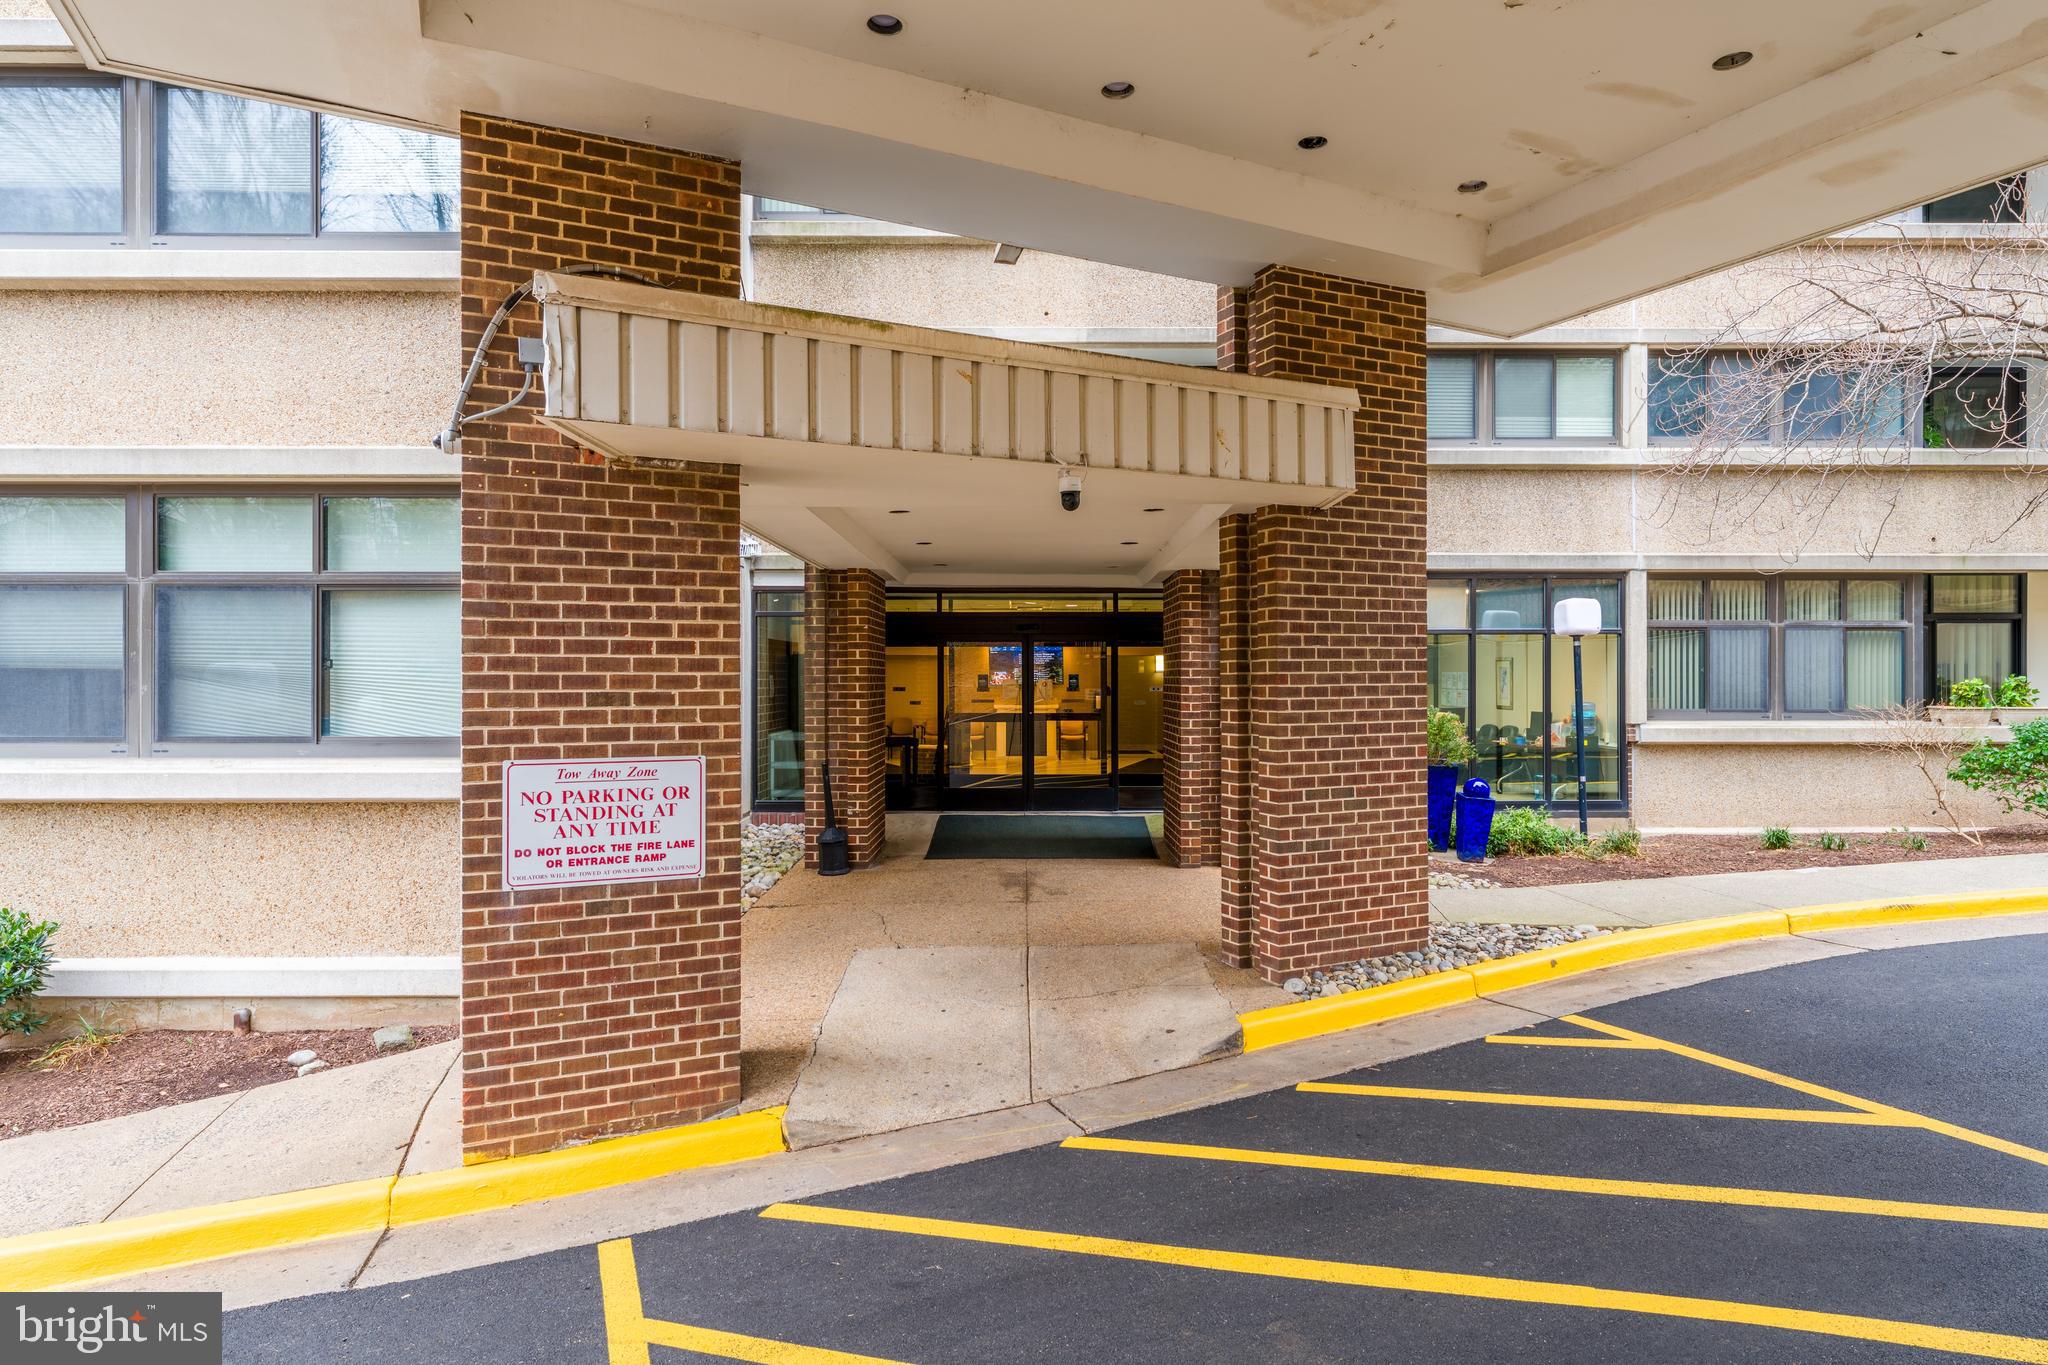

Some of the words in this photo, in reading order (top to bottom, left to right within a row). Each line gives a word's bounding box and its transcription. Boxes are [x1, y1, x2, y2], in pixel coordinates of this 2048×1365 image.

[557, 768, 582, 780] Tow
[587, 767, 621, 780] Away
[626, 766, 658, 777] Zone
[520, 790, 553, 806] NO
[561, 787, 654, 804] PARKING
[662, 785, 690, 801] OR
[534, 804, 644, 823] STANDING
[652, 802, 678, 817] AT
[553, 822, 598, 839] ANY
[606, 820, 661, 836] TIME
[514, 849, 532, 858] DO
[537, 847, 562, 856] NOT
[566, 844, 606, 855] BLOCK
[611, 843, 632, 852] THE
[637, 841, 662, 851] FIRE
[666, 839, 695, 849] LANE
[546, 859, 563, 868] OR
[568, 855, 630, 867] ENTRANCE
[634, 853, 667, 863] RAMP
